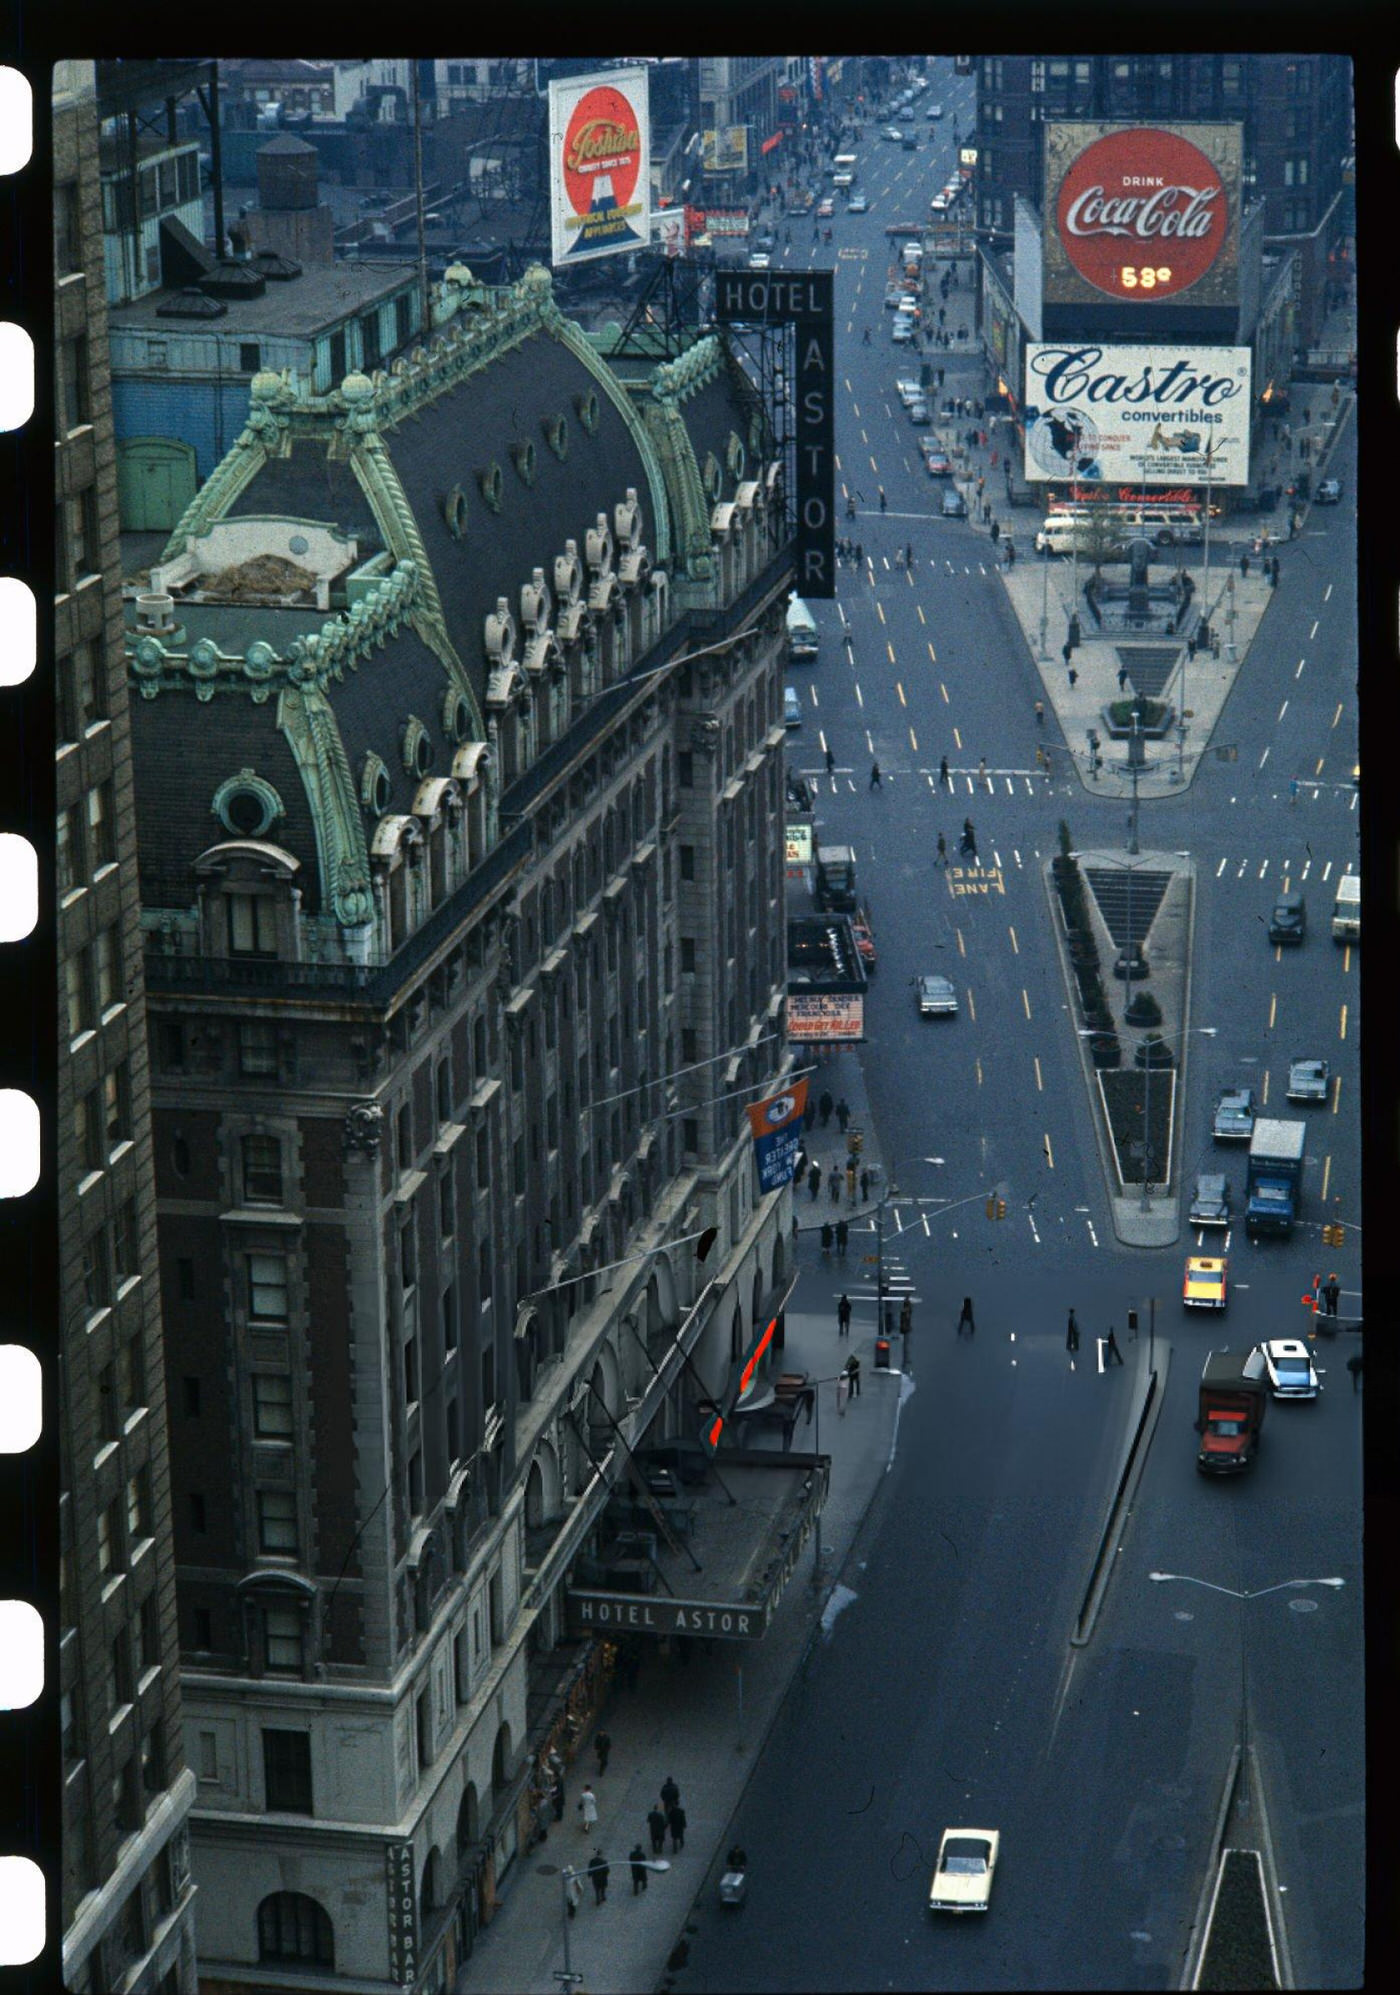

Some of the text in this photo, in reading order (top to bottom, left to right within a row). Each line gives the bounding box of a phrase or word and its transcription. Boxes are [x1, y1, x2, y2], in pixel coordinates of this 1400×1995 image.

[1123, 176, 1164, 186] DRINK
[1066, 185, 1220, 238] Coca-Cola
[726, 282, 823, 312] HOTEL
[1031, 348, 1242, 406] Castro
[1122, 409, 1223, 423] convertibles
[803, 339, 825, 581] ASTOR
[953, 868, 997, 878] FIRE
[954, 883, 1003, 895] LANE
[582, 1602, 749, 1633] HOTEL ASTOR
[400, 1847, 415, 1982] ASTOR BAR
